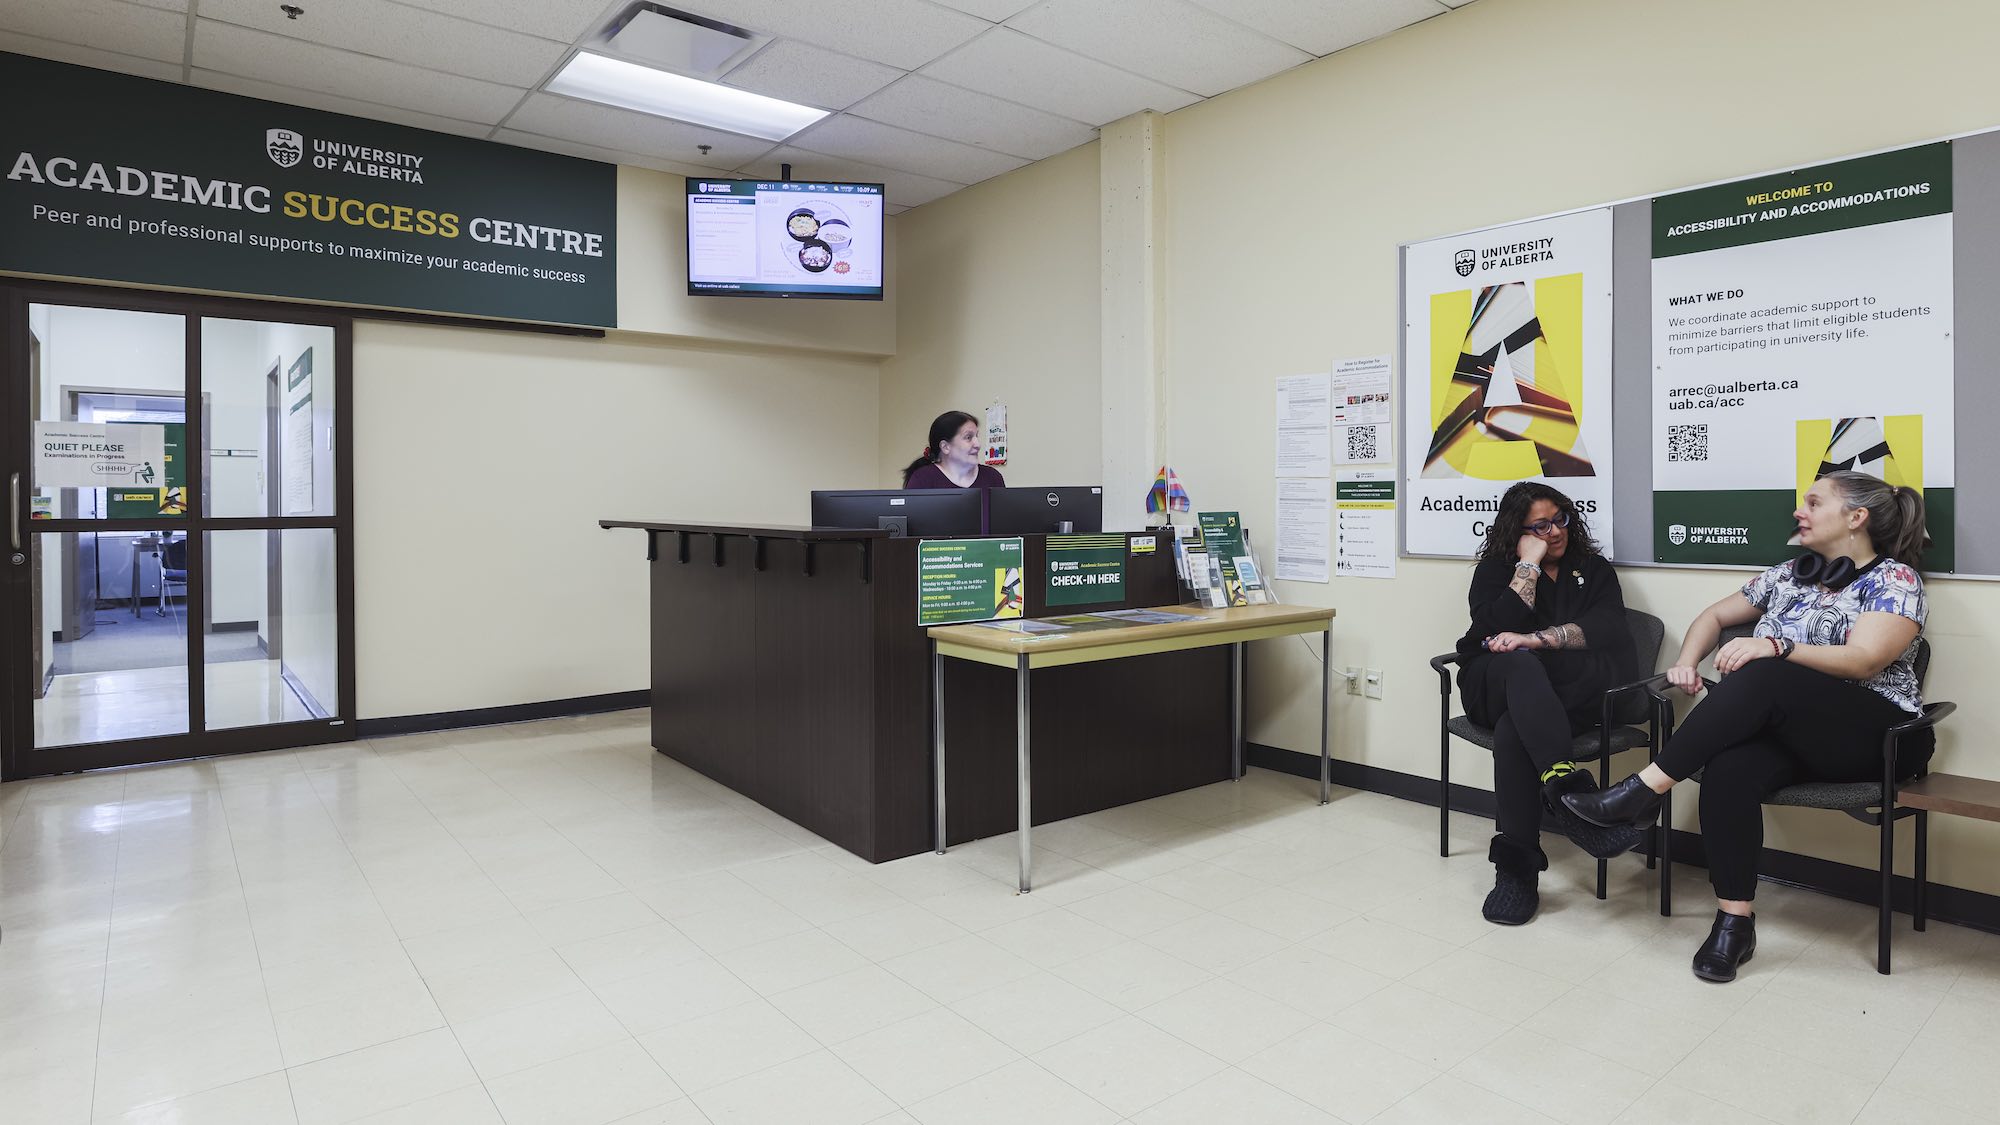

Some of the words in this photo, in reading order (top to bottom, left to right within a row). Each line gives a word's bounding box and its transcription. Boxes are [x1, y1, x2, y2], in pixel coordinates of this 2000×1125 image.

[313, 138, 423, 168] UNIVERSITY
[313, 155, 338, 170] OF
[342, 160, 424, 184] ALBERTA
[1746, 184, 1811, 206] WELCOME
[1814, 181, 1833, 193] TO
[7, 152, 271, 214] ACADEMIC
[283, 191, 460, 238] SUCCESS
[468, 217, 603, 258] CENTRE
[1667, 213, 1758, 237] ACCESSIBILITY
[1760, 208, 1787, 222] AND
[1790, 182, 1930, 216] ACCOMMODATIONS
[33, 204, 80, 225] Peer
[86, 214, 122, 230] and
[128, 220, 243, 244] professional
[249, 234, 324, 254] supports
[328, 241, 344, 256] to
[350, 246, 422, 265] maximize
[426, 254, 458, 270] your
[462, 259, 529, 278] academic
[533, 268, 586, 284] success
[1482, 238, 1553, 258] UNIVERSITY
[1482, 260, 1496, 270] OF
[1500, 250, 1554, 268] ALBERTA
[1669, 294, 1703, 306] WHAT
[1706, 291, 1724, 302] WE
[1727, 289, 1744, 299] DO
[1669, 317, 1686, 327] We
[1688, 310, 1747, 325] coordinate
[1750, 303, 1808, 318] academic
[1811, 298, 1859, 314] support
[1862, 296, 1875, 305] to
[1668, 328, 1717, 341] minimize
[1720, 323, 1764, 337] barriers
[1767, 320, 1790, 331] that
[1793, 317, 1820, 328] limit
[1823, 312, 1868, 327] eligible
[1872, 305, 1930, 321] students
[1668, 346, 1694, 355] from
[1697, 338, 1767, 355] participating
[1770, 337, 1780, 346] in
[1784, 330, 1842, 345] university
[1846, 328, 1869, 338] life.
[1669, 378, 1798, 397] arrec@ualberta.ca
[1669, 397, 1744, 410] uab.ca/acc
[44, 442, 79, 451] QUIET
[82, 444, 124, 452] PLEASE
[1420, 496, 1500, 512] Academi
[1690, 526, 1748, 536] UNIVERSITY
[1690, 536, 1704, 544] OF
[1705, 535, 1748, 544] ALBERTA
[1051, 574, 1096, 586] CHECK-IN
[1098, 573, 1120, 584] HERE
